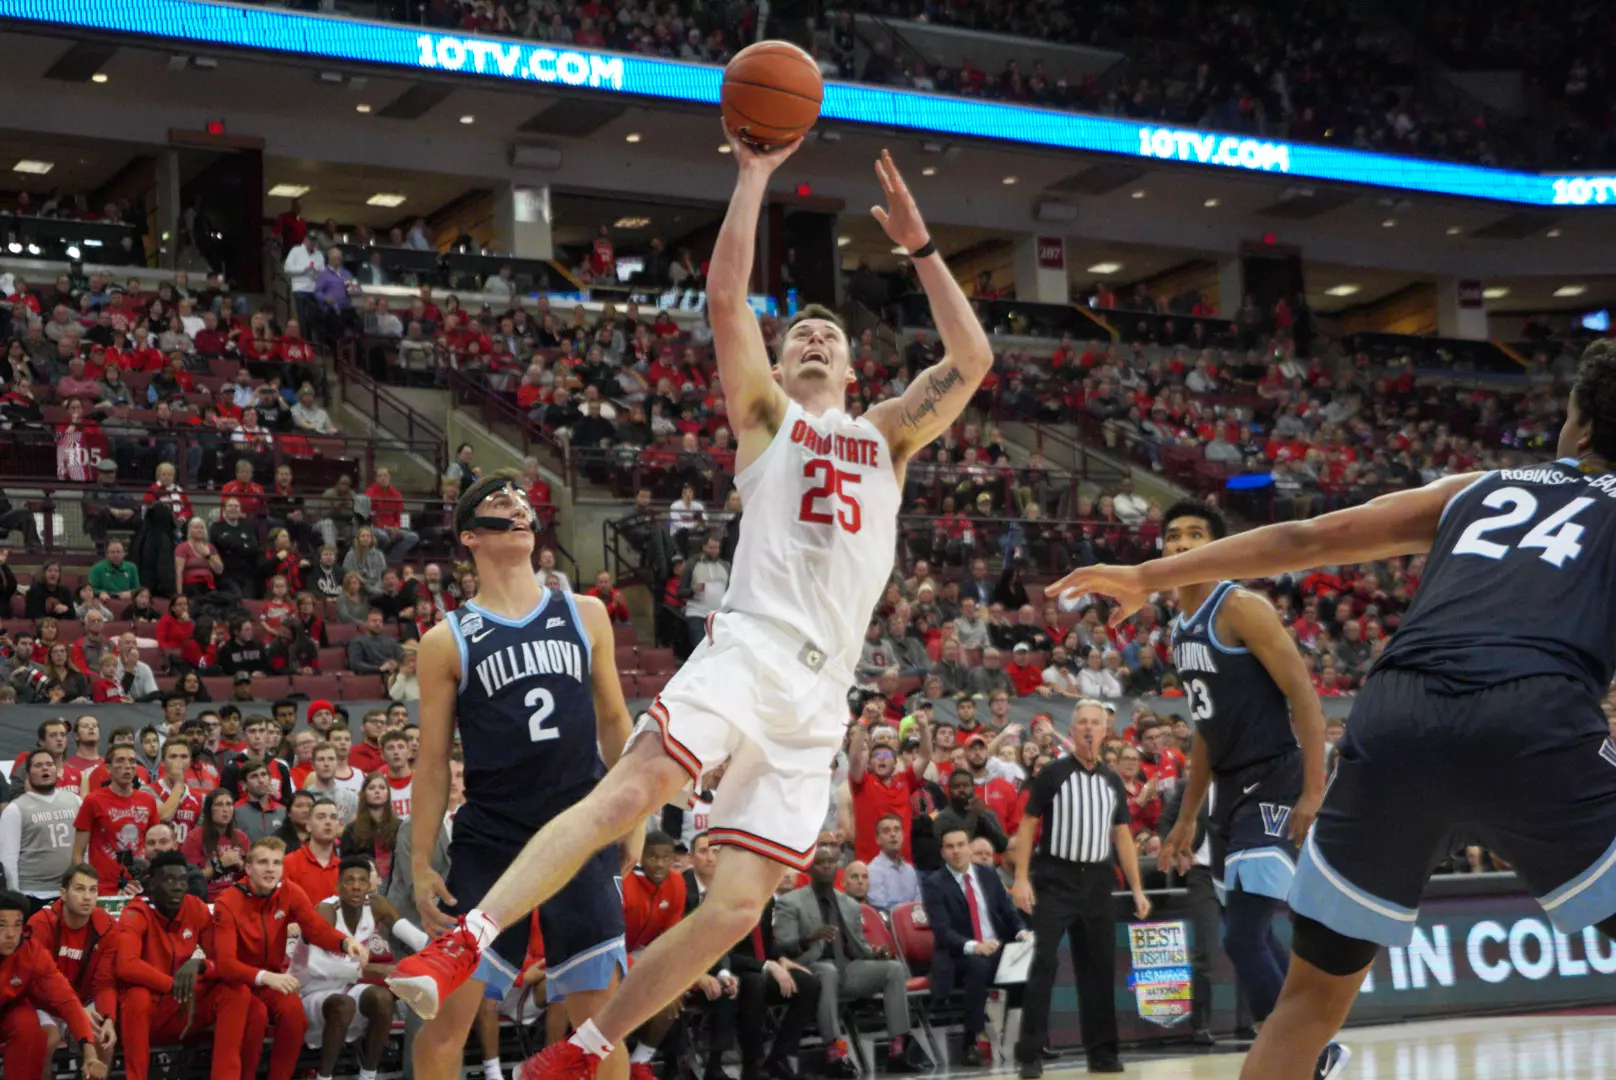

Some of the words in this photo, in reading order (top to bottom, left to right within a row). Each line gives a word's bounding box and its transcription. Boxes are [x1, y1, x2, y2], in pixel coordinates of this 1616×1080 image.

[416, 33, 623, 91] 10TV.COM
[1138, 127, 1290, 173] 10TV.COM
[790, 418, 833, 456] OHIO
[798, 457, 862, 535] 25
[1451, 486, 1597, 569] 24
[474, 639, 583, 698] VILLANOVA
[524, 687, 561, 743] 2
[1182, 678, 1214, 721] 23
[47, 822, 71, 848] 12
[1258, 802, 1291, 837] V
[1132, 926, 1181, 949] BEST
[1388, 922, 1454, 991] IN
